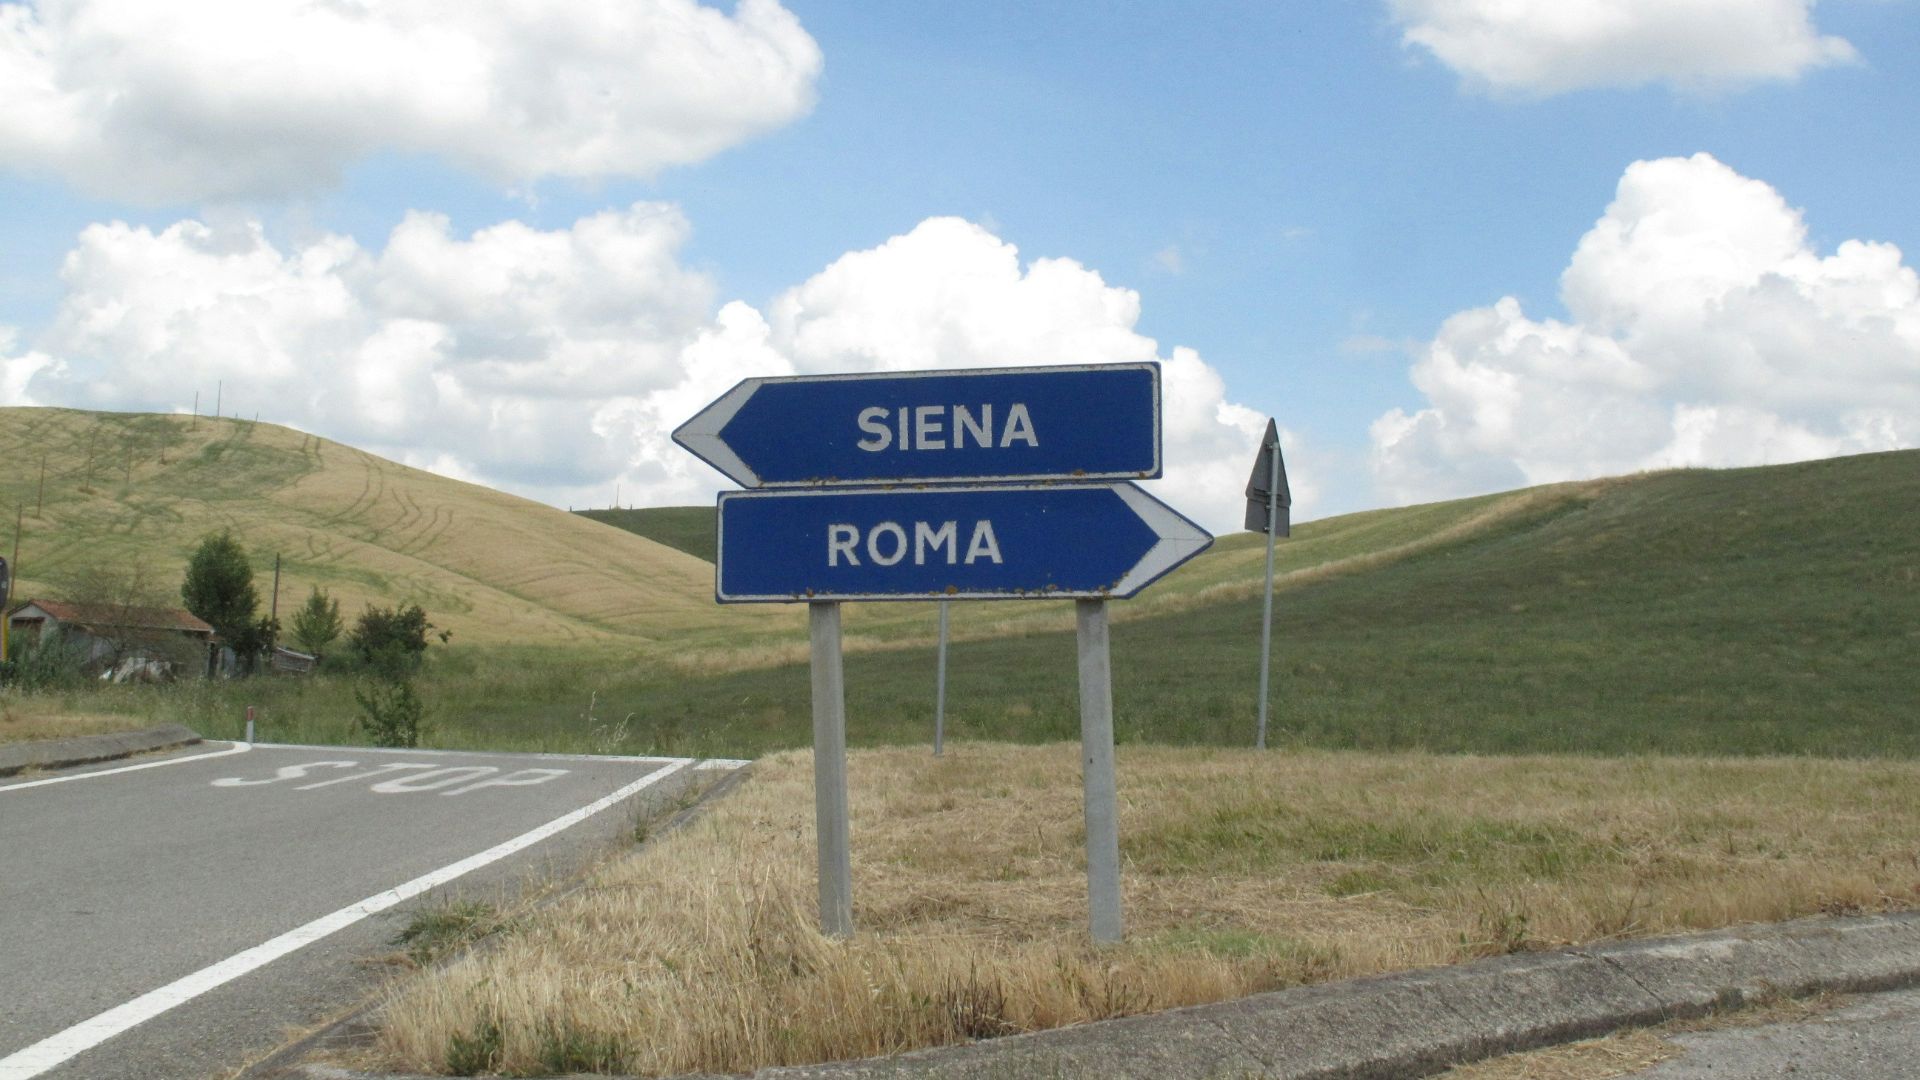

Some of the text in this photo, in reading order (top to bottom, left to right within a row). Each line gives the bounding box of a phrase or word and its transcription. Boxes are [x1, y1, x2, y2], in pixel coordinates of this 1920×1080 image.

[857, 403, 1039, 452] SIENA
[828, 519, 1003, 567] ROMA
[210, 760, 571, 796] STOP
